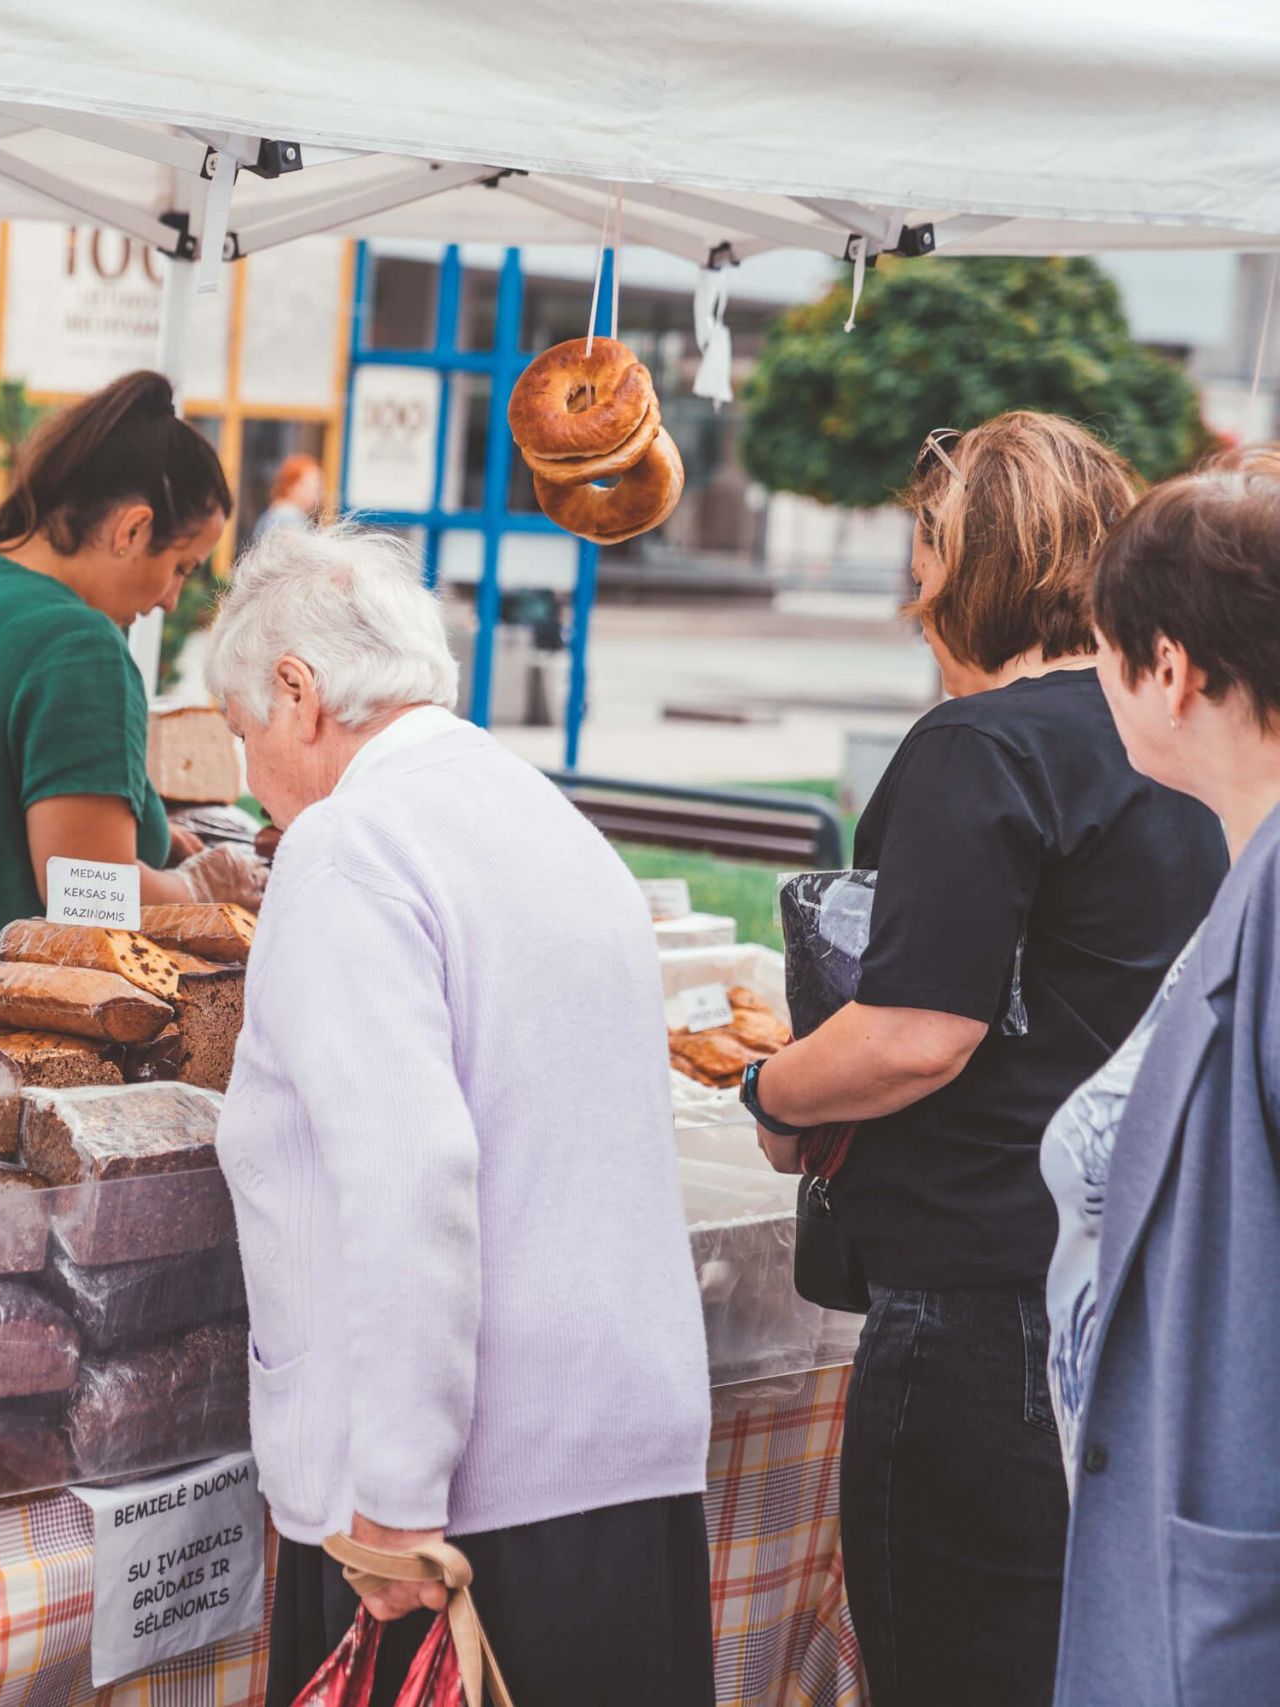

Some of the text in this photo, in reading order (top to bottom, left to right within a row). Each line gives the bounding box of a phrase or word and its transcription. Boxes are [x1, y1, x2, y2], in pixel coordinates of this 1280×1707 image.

[64, 887, 125, 902] KEKSAS SU
[70, 868, 117, 881] MEDAUS
[63, 906, 125, 922] RAZINOMIS
[114, 1465, 249, 1528] BEMIELĖ DUONA
[127, 1525, 244, 1583] SU ĮVAIRIAIS
[132, 1558, 230, 1611] GRŪDAIS IR
[133, 1587, 230, 1639] SĖLENOMIS
